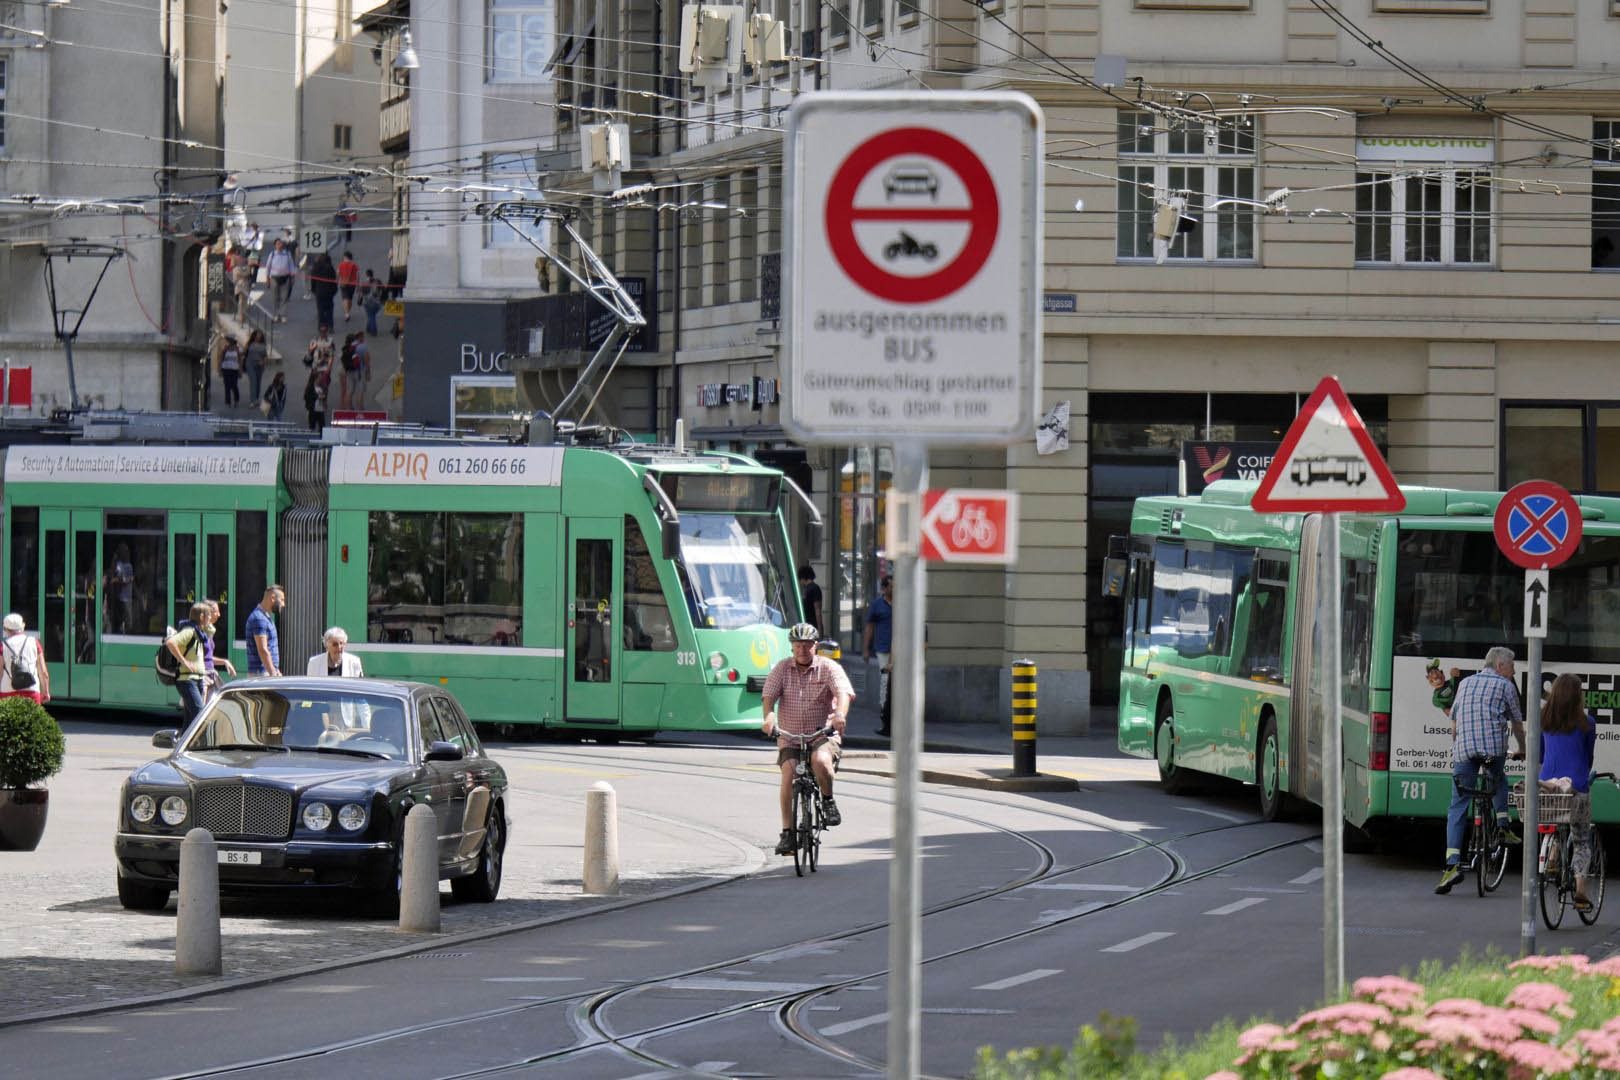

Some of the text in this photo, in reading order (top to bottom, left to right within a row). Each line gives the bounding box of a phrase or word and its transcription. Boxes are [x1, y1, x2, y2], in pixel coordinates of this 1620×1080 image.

[305, 231, 322, 249] 18
[814, 310, 1007, 338] ausgenommen
[883, 337, 937, 363] BUS
[938, 371, 1016, 395] gestattet
[21, 455, 56, 476] Security
[64, 456, 114, 473] Automation
[120, 457, 151, 473] Service
[161, 456, 203, 474] Unterhalt
[209, 459, 219, 474] IT
[228, 457, 260, 474] TelCom
[365, 452, 527, 481] ALPIQ 061 260 66 66
[676, 651, 697, 665] 313
[1396, 747, 1448, 759] Gerber-Vogt
[1396, 759, 1411, 768] Tel.
[1412, 760, 1428, 768] 061
[1431, 761, 1447, 769] 487
[1401, 780, 1427, 801] 781
